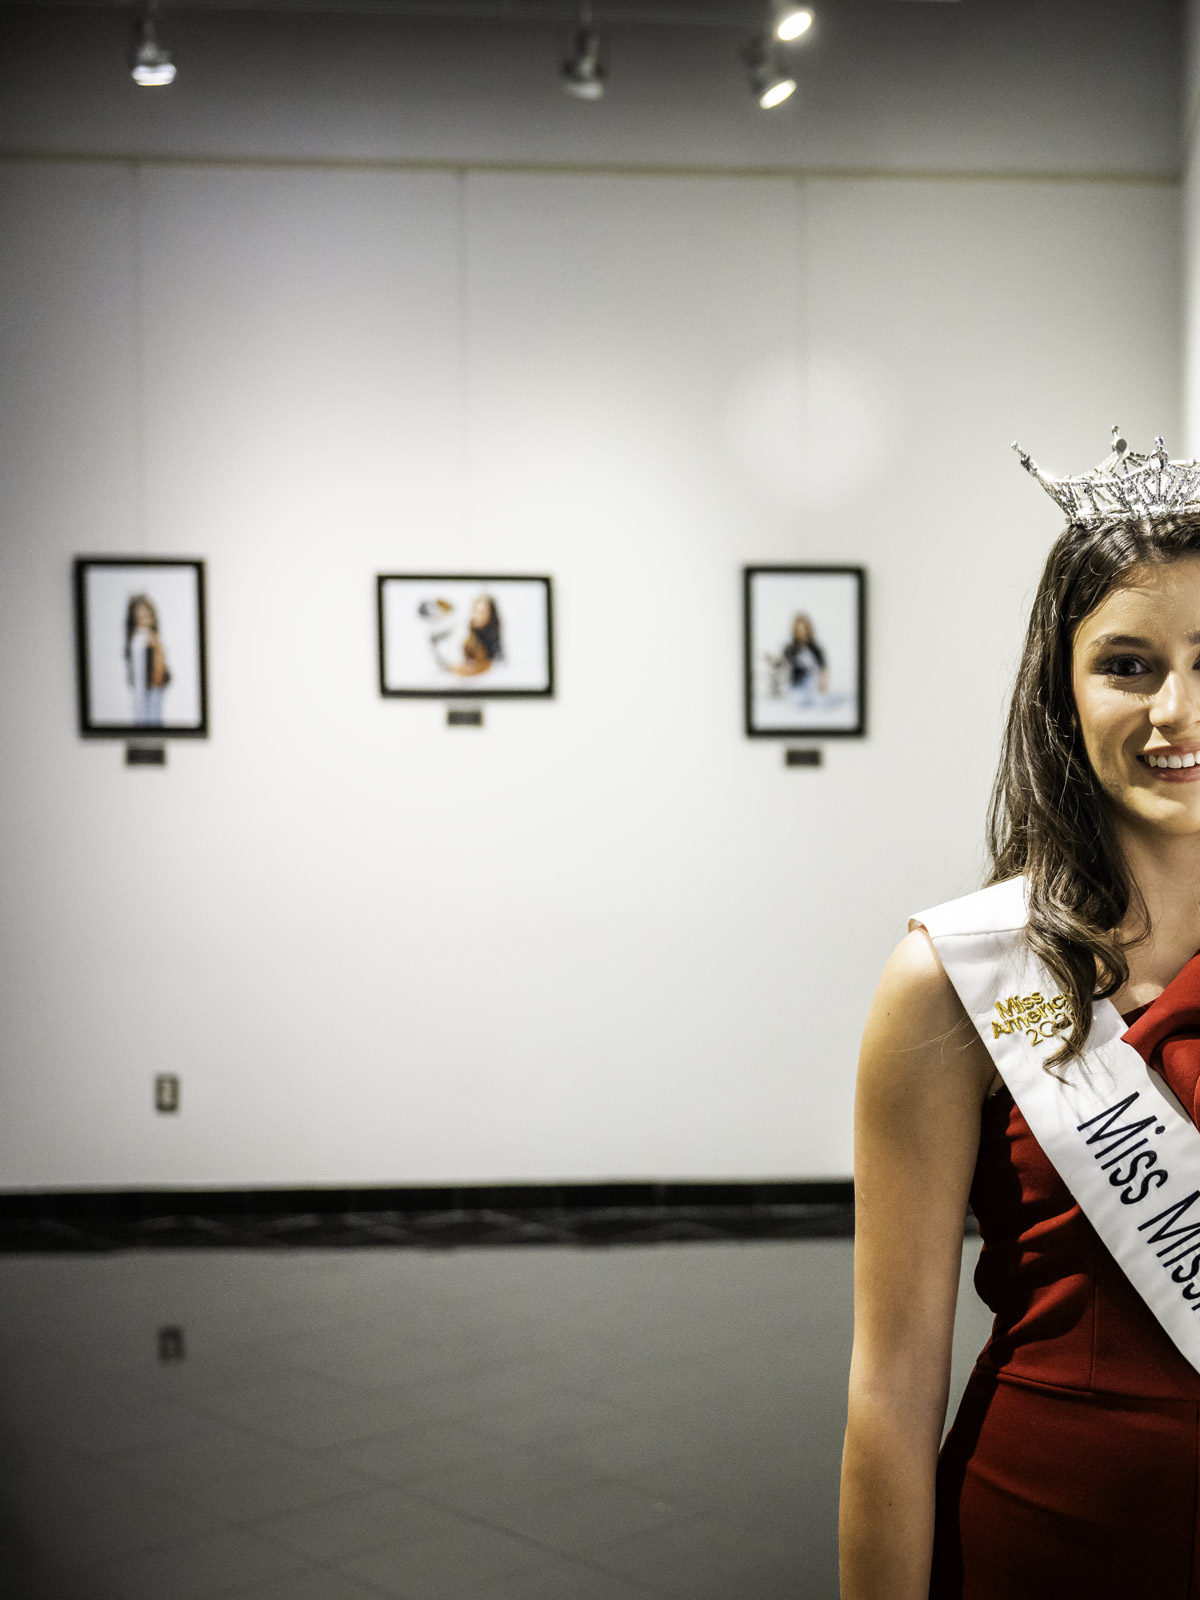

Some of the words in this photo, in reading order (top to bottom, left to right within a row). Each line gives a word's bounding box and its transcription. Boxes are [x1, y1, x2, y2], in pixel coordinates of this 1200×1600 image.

[992, 995, 1067, 1039] Americ
[994, 992, 1044, 1020] Miss
[1076, 1091, 1169, 1205] Miss
